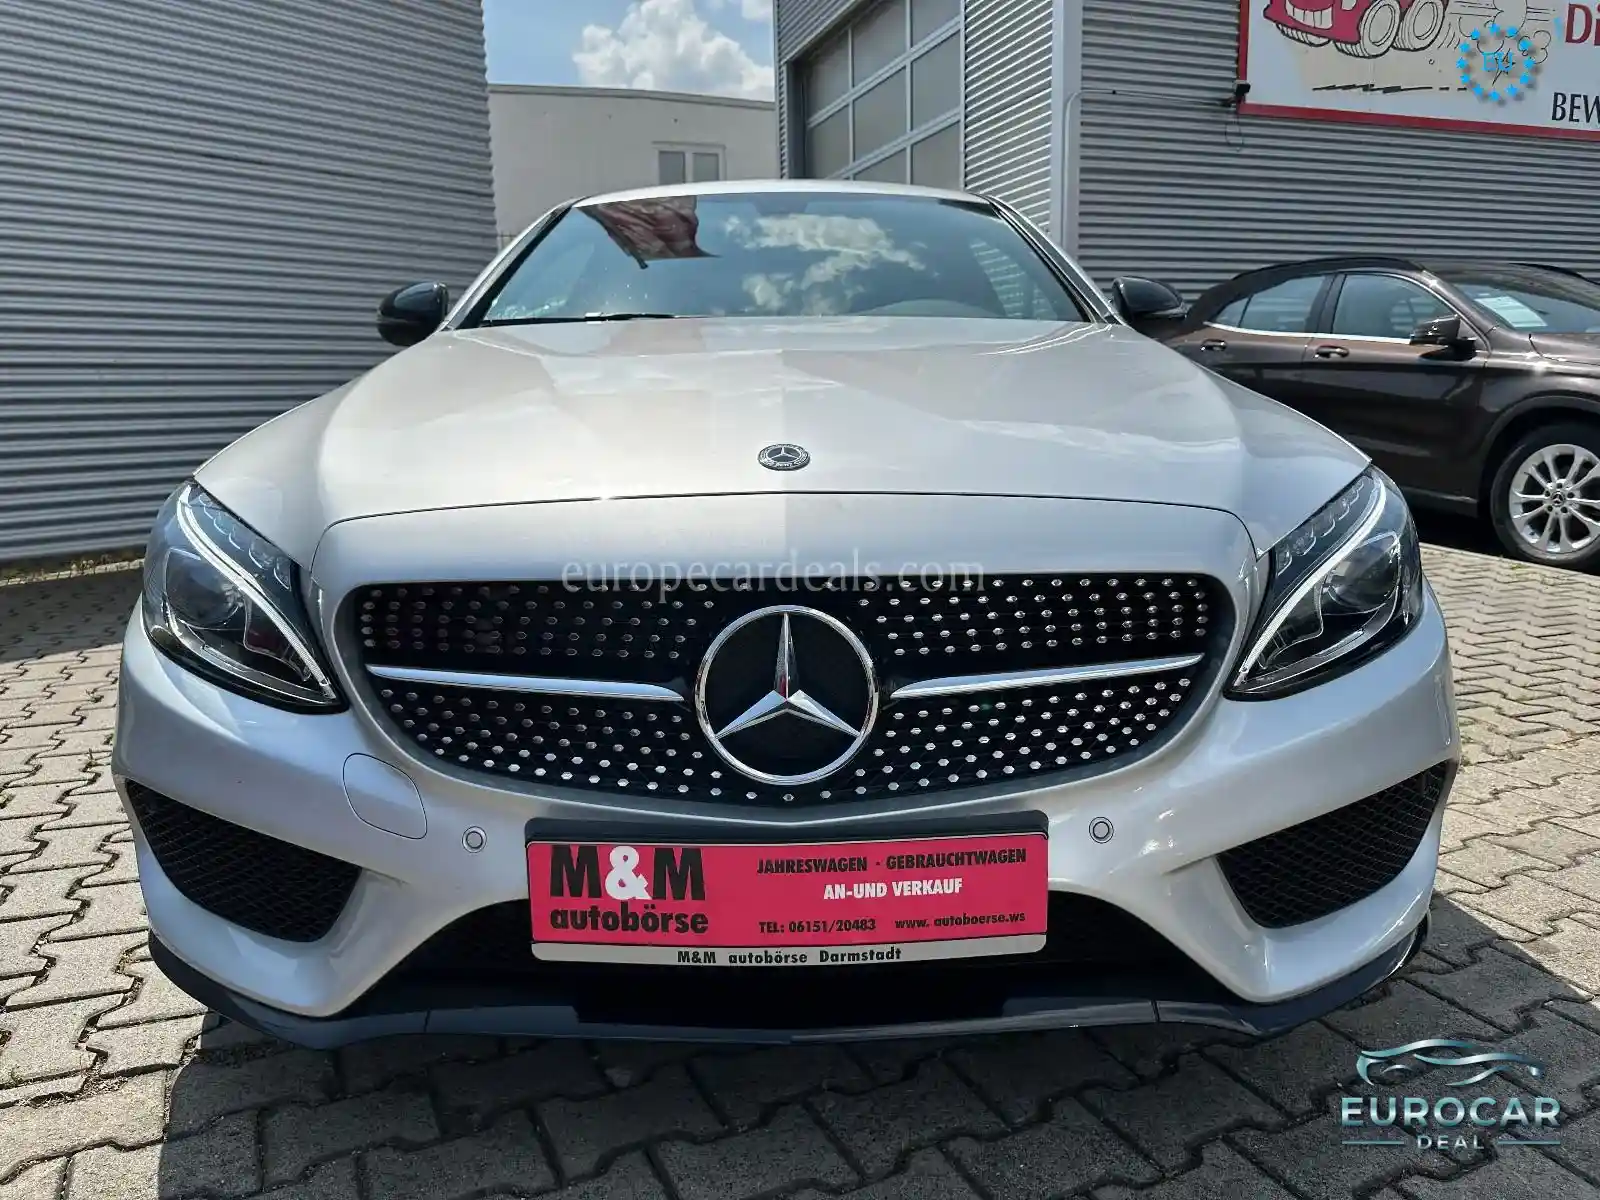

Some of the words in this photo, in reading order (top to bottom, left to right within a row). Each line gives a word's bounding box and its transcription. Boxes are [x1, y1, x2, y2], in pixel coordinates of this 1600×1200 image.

[550, 844, 706, 901] M&M
[757, 857, 868, 874] JAHRESWAGEN
[886, 848, 1027, 871] GEBRAUCHTWAGEN
[823, 881, 888, 900] AN-UND
[892, 877, 963, 897] VERKAUF
[550, 901, 709, 934] autobörse
[759, 921, 785, 934] TEL:
[788, 918, 877, 934] 06151/20483
[934, 912, 1026, 927] autoboerse.ws
[677, 950, 717, 965] M&M
[728, 949, 808, 966] autobörse
[819, 947, 902, 963] Darmstadt
